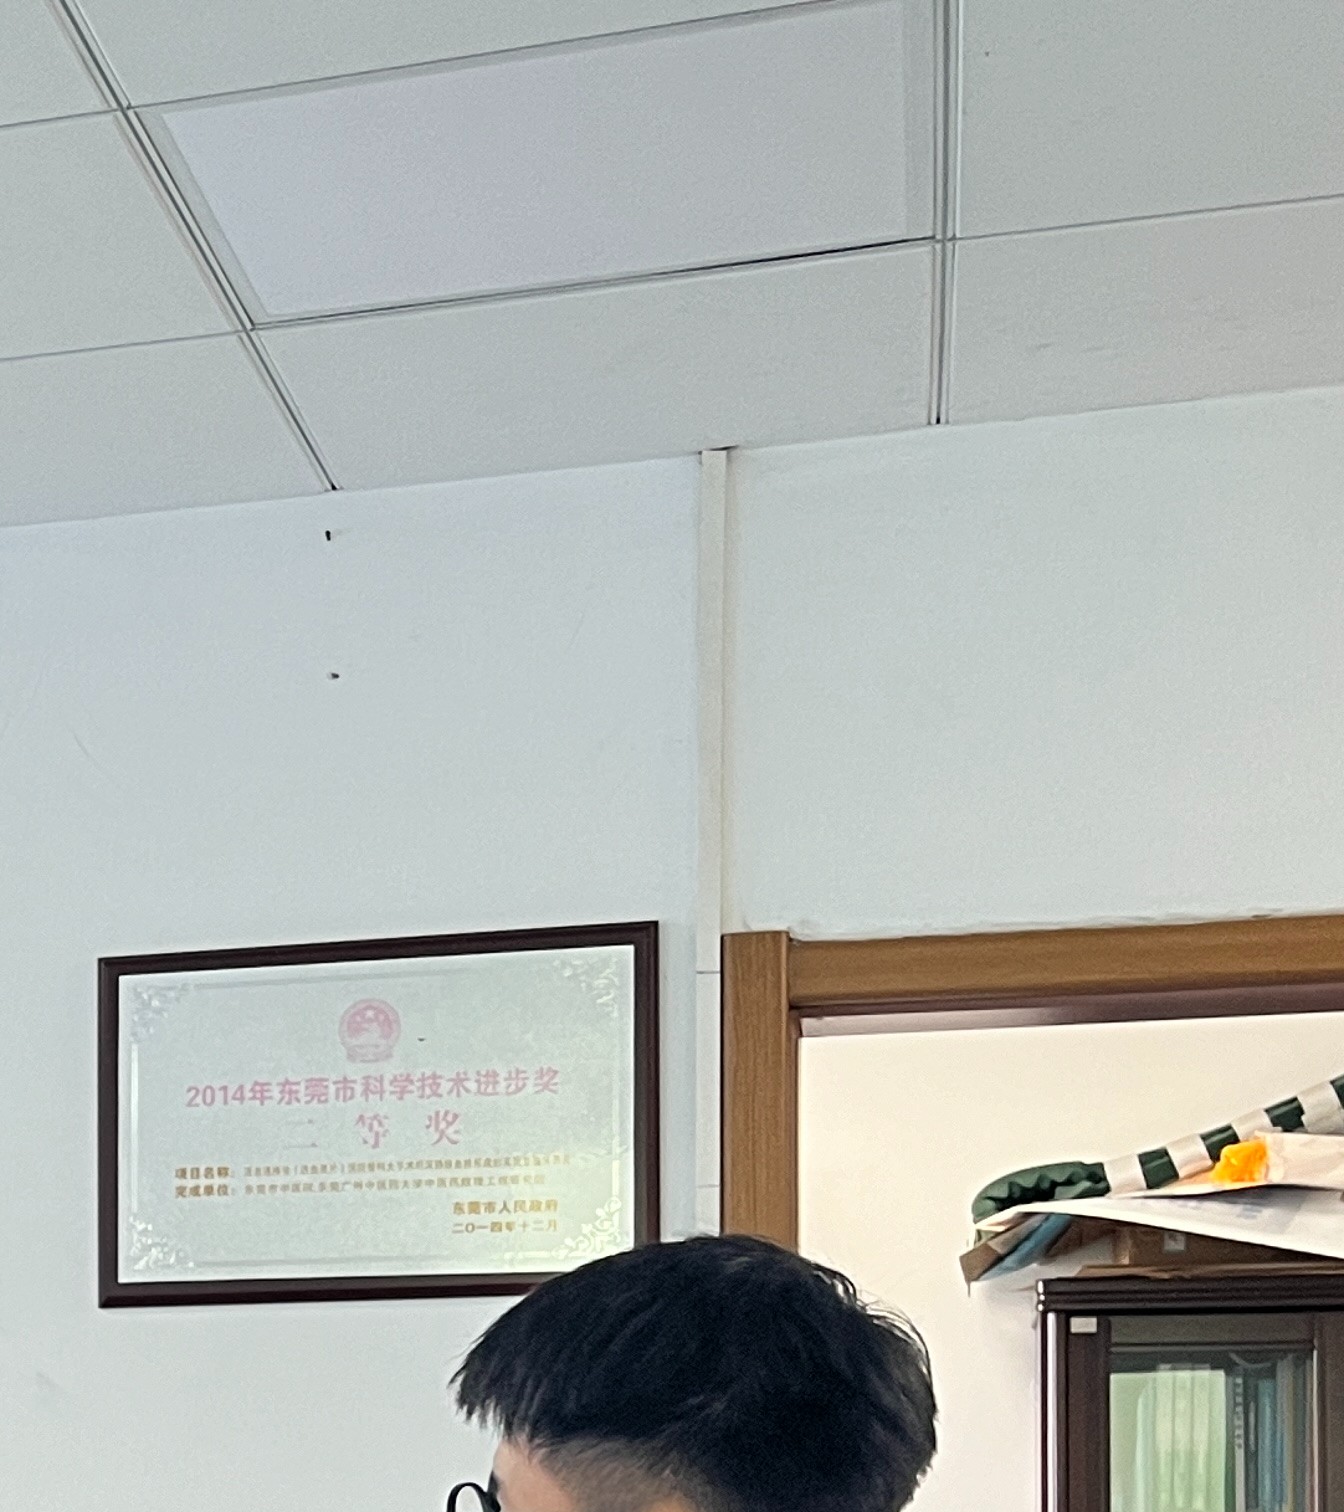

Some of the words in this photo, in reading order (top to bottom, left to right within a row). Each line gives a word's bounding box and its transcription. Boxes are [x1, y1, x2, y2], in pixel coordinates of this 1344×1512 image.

[185, 1066, 560, 1108] 2014年东莞市科学技术进步奖
[283, 1109, 462, 1150] 二等奖
